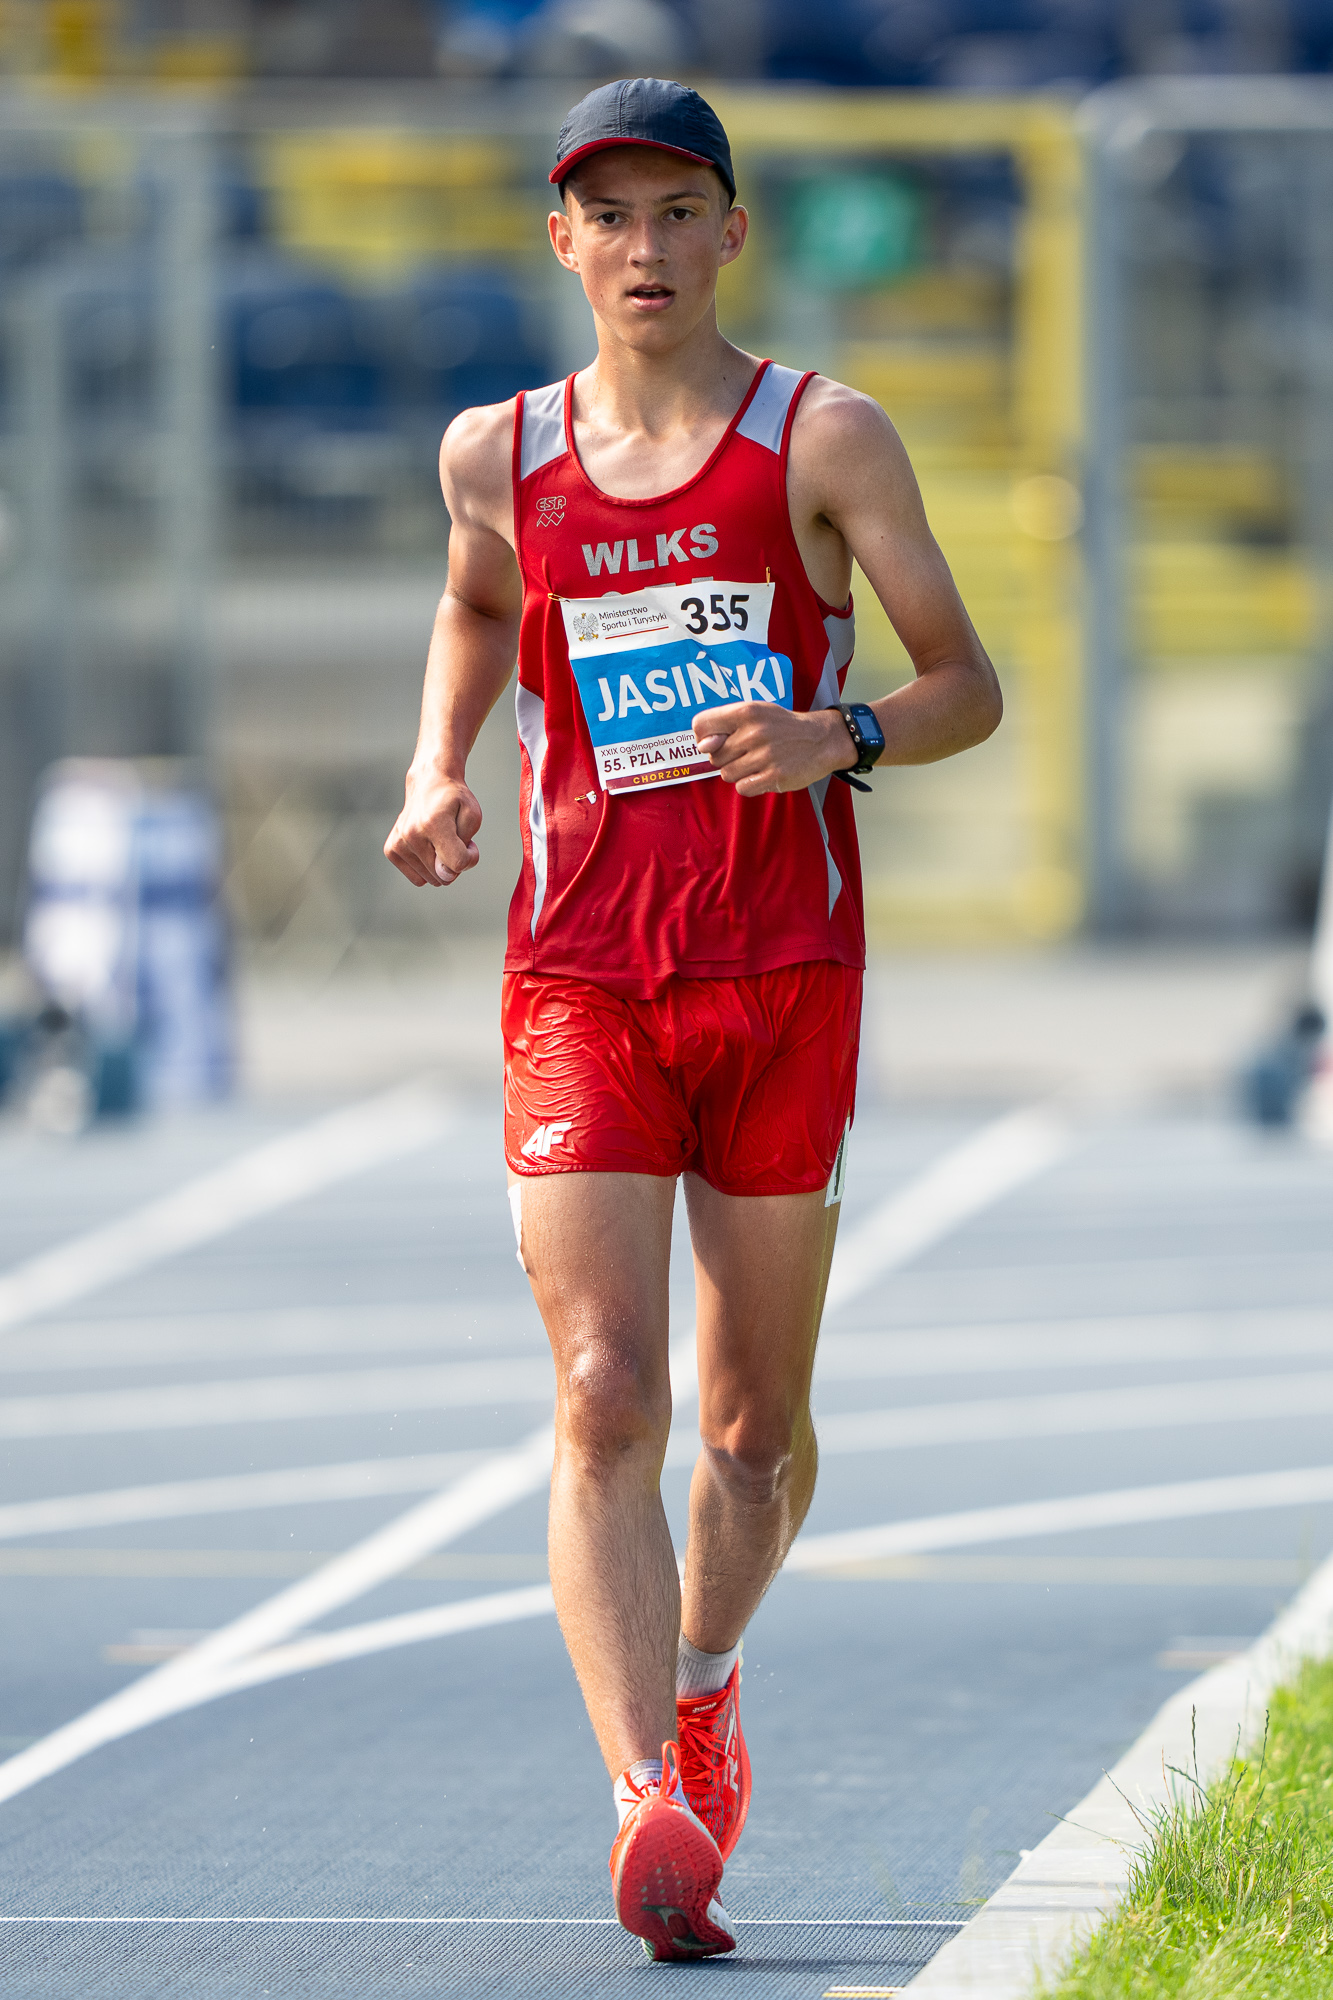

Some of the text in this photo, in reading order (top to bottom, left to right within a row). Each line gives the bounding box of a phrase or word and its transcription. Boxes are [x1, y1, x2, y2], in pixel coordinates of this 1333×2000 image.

[581, 523, 719, 576] WLKS
[599, 606, 648, 620] Ministerstwo
[602, 612, 667, 631] Sportu i Turystyki
[680, 594, 750, 635] 355
[597, 650, 785, 722] JASIŃSKI
[600, 733, 695, 757] XXIX Ogólnopolska Olim
[604, 743, 702, 773] 55. PZLA Mist
[633, 767, 690, 784] CHORZÓW
